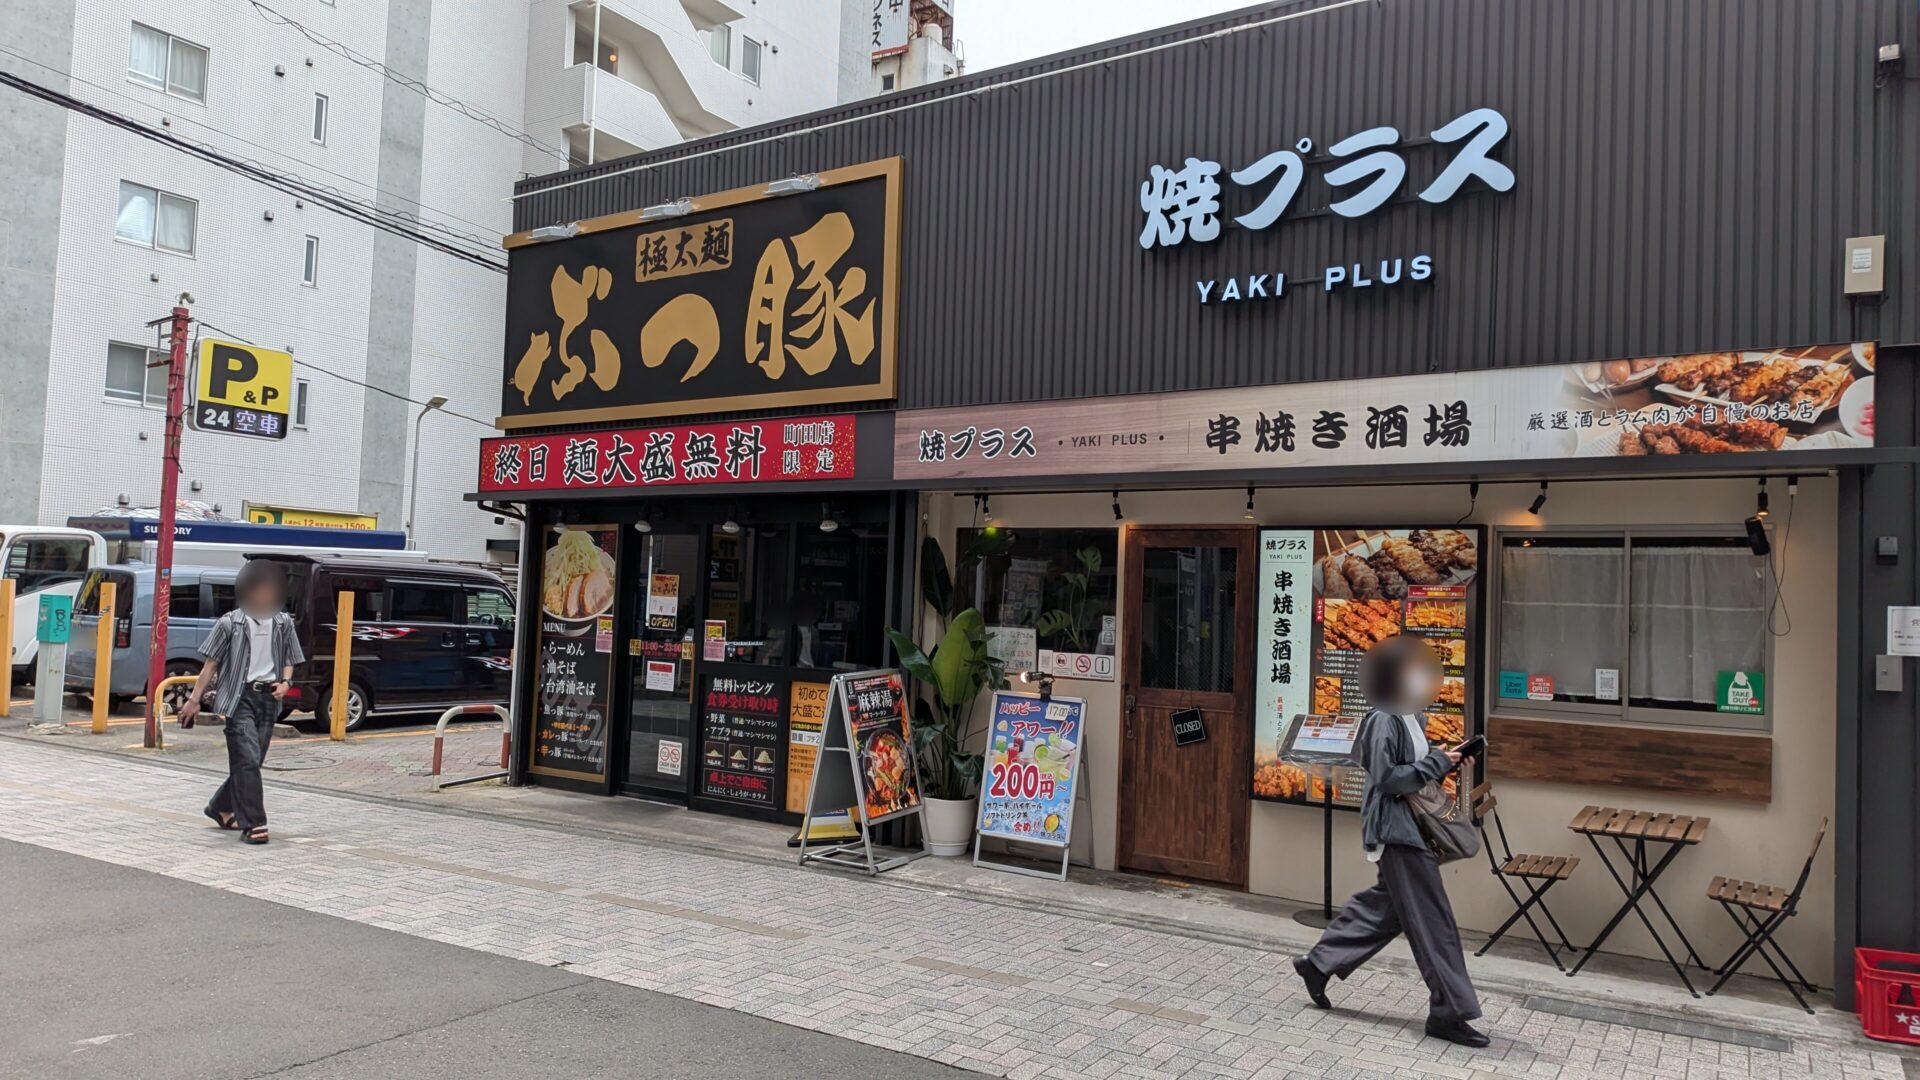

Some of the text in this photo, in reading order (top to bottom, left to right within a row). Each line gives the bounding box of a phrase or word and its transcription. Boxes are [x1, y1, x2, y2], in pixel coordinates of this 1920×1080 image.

[1139, 108, 1515, 250] 焼プラス
[639, 221, 731, 278] 極太麺
[1197, 255, 1432, 303] YAKI PLUS
[203, 408, 279, 435] 24 空車
[919, 398, 1815, 463] 焼プラス YAKI PLUS 串焼き酒場 厳選酒とラム肉が自慢のお店
[782, 420, 835, 447] 町田店
[494, 425, 767, 486] 終日 麺大盛無料
[781, 447, 835, 475] 限定
[143, 524, 193, 535] SUORY
[1265, 538, 1307, 551] 焼プラス
[543, 622, 567, 633] MENU
[650, 616, 676, 628] OPEN
[1271, 570, 1294, 685] 串焼き酒場
[549, 641, 586, 656] らーめん
[546, 660, 577, 675] 油そば
[546, 679, 597, 696] 台湾油そば
[712, 677, 775, 696] 無料トッピング
[1732, 690, 1750, 698] TAKE
[858, 689, 893, 712] 麻辣湯
[999, 701, 1041, 716] ハッピー
[710, 713, 726, 724] 野菜
